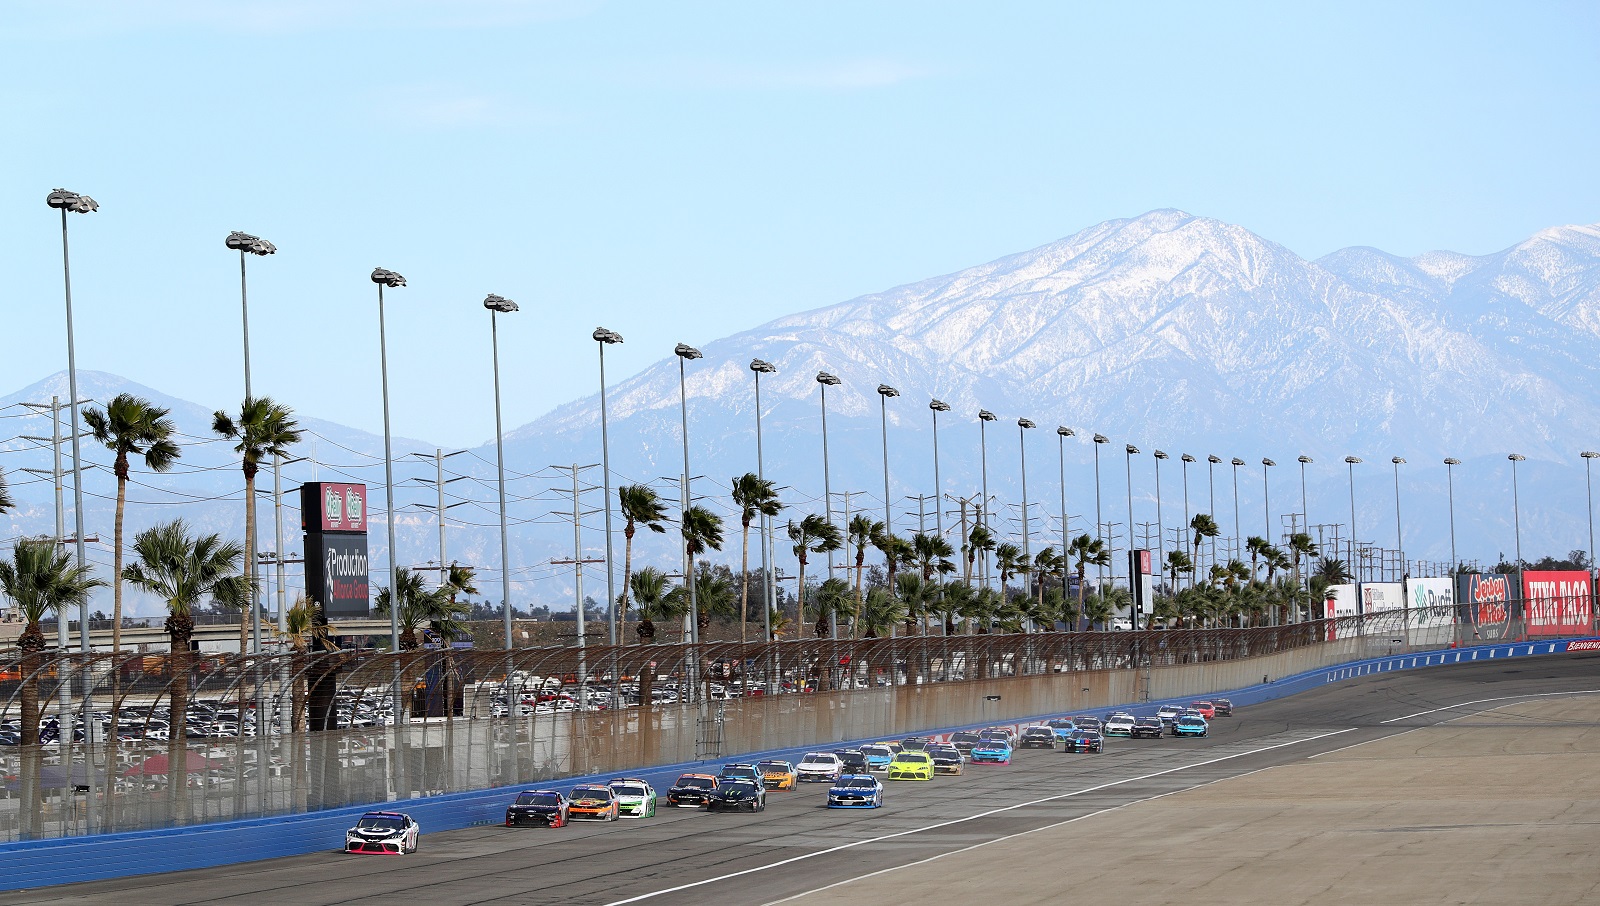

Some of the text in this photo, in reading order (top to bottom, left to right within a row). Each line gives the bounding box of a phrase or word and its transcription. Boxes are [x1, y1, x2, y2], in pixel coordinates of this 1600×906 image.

[331, 549, 368, 577] Production
[333, 579, 368, 603] Alliance Group
[1475, 574, 1506, 602] Jersey
[1529, 580, 1589, 626] KING TACO
[1486, 628, 1499, 640] SUBS
